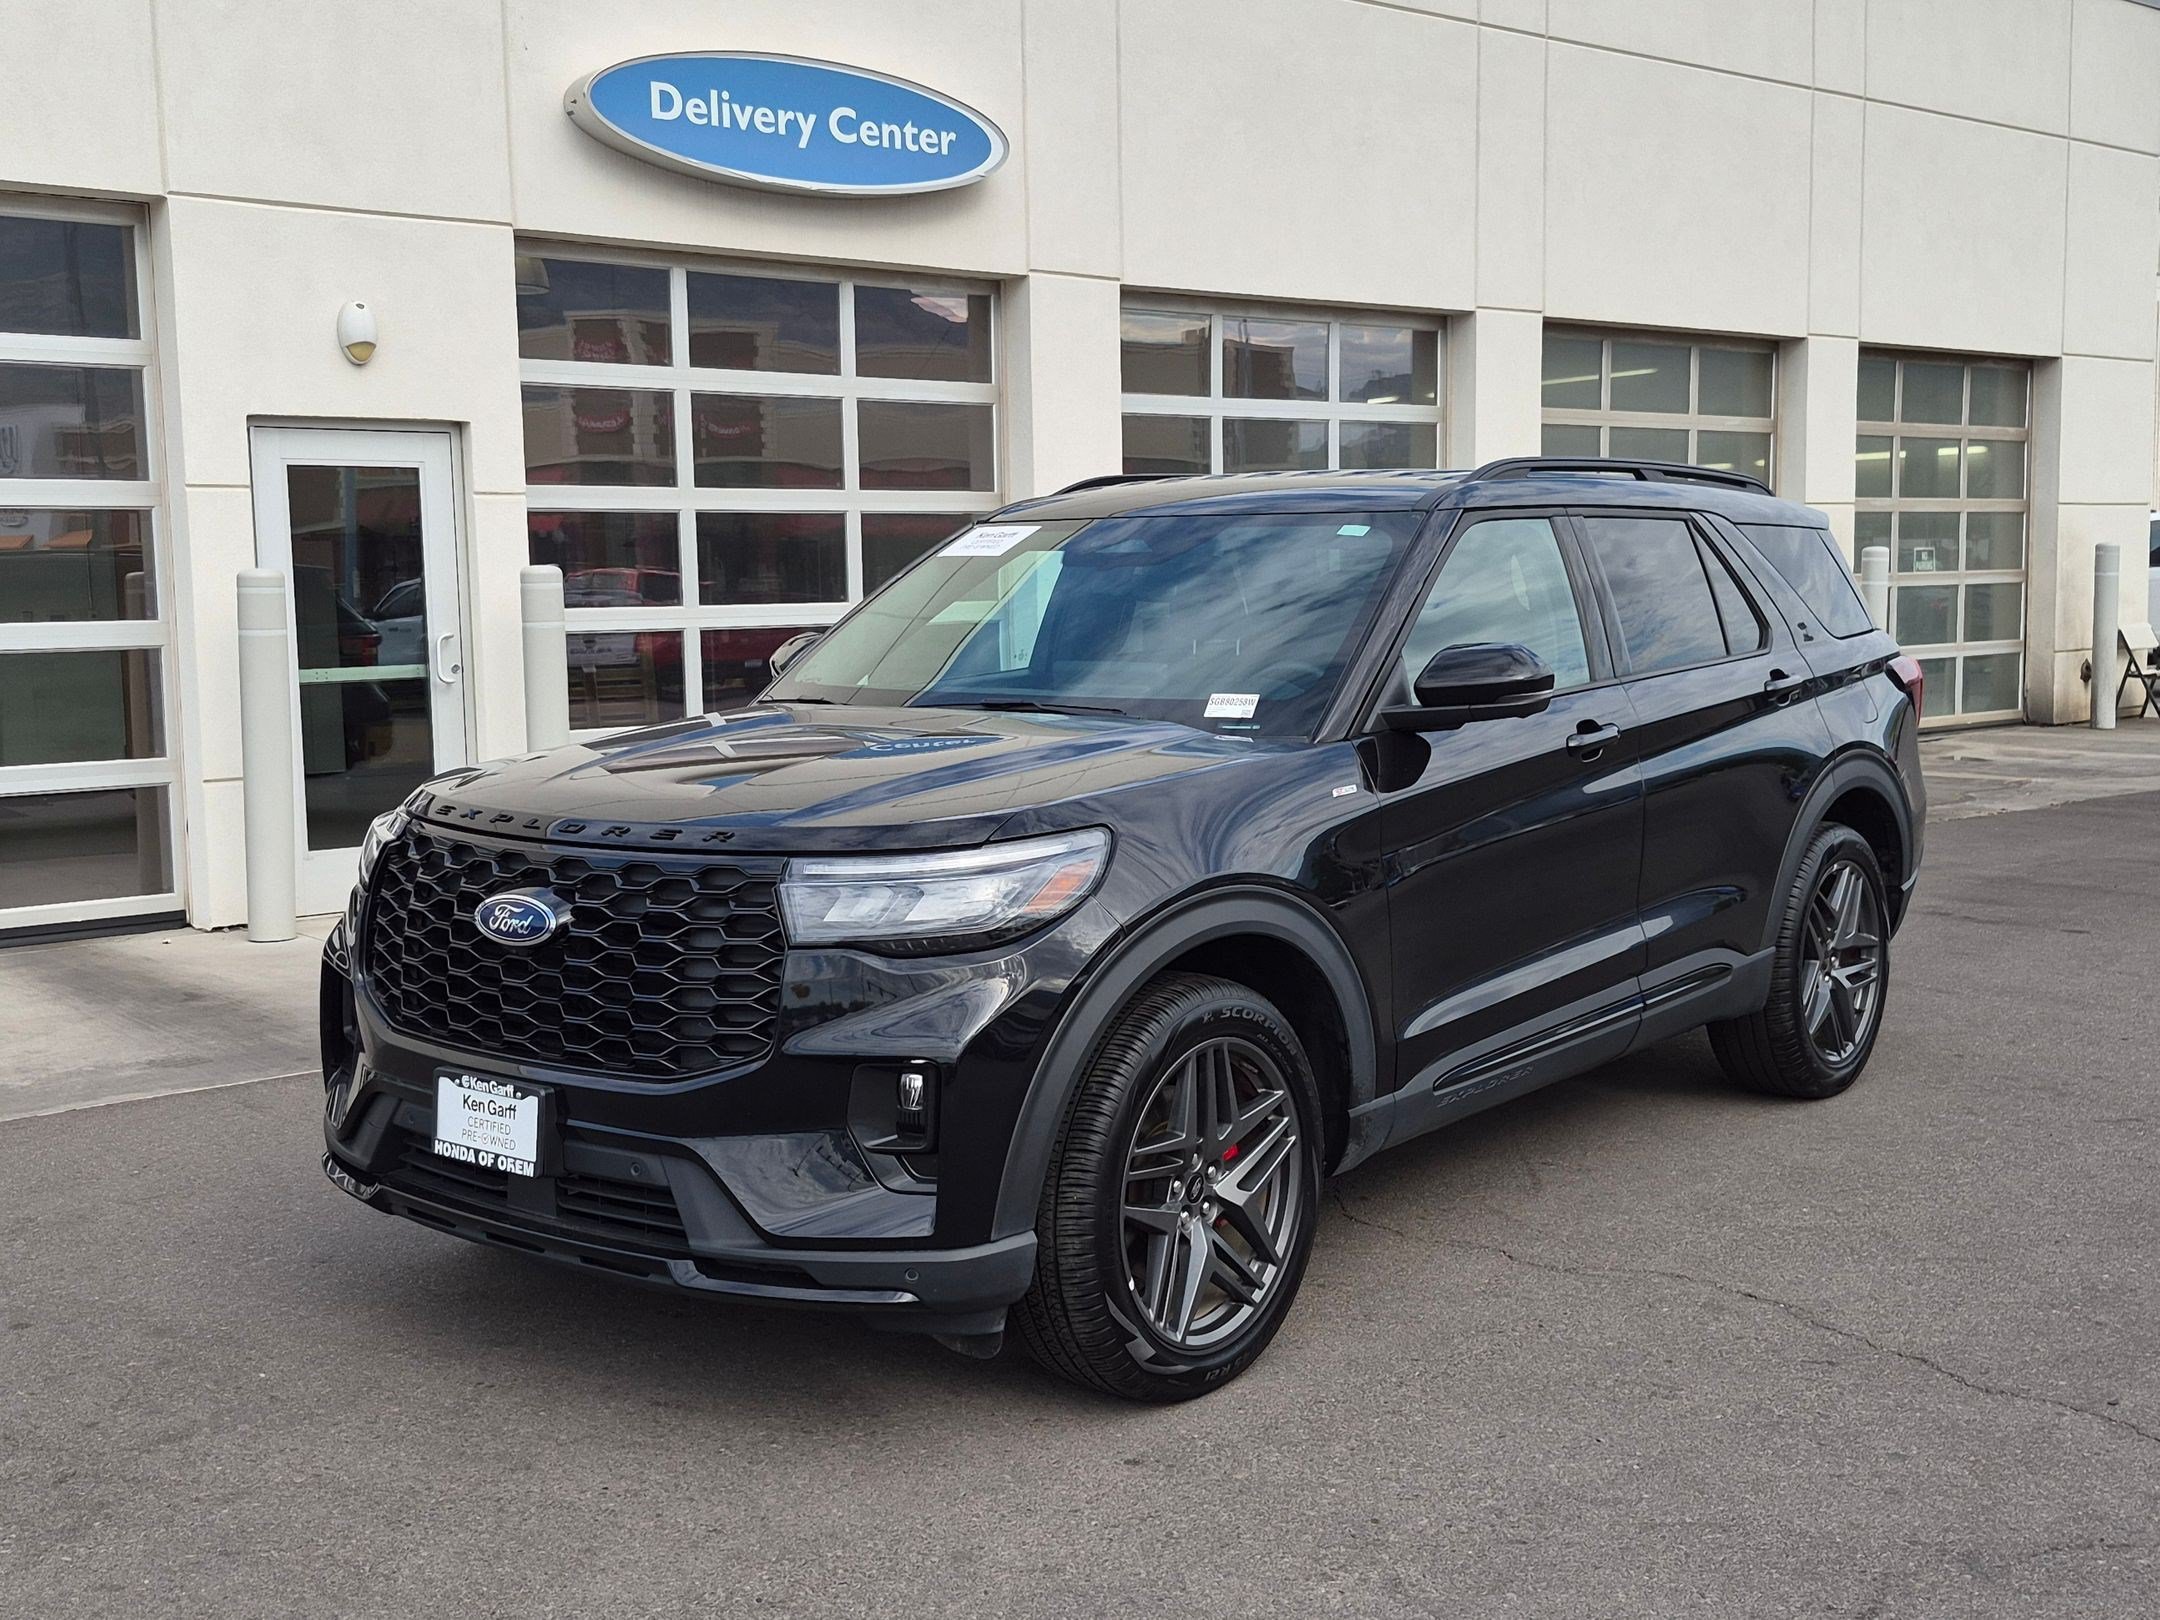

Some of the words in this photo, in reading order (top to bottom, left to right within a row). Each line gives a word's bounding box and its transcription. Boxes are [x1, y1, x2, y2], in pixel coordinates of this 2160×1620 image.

[650, 80, 817, 149] Delivery
[828, 106, 957, 155] Center
[434, 803, 736, 843] EXPLORER
[489, 904, 534, 935] Ford
[467, 1115, 512, 1135] CERTIFIED
[487, 1099, 517, 1120] Garff
[434, 1139, 476, 1164] HONDA
[478, 1151, 496, 1168] OF
[497, 1155, 535, 1177] OREM
